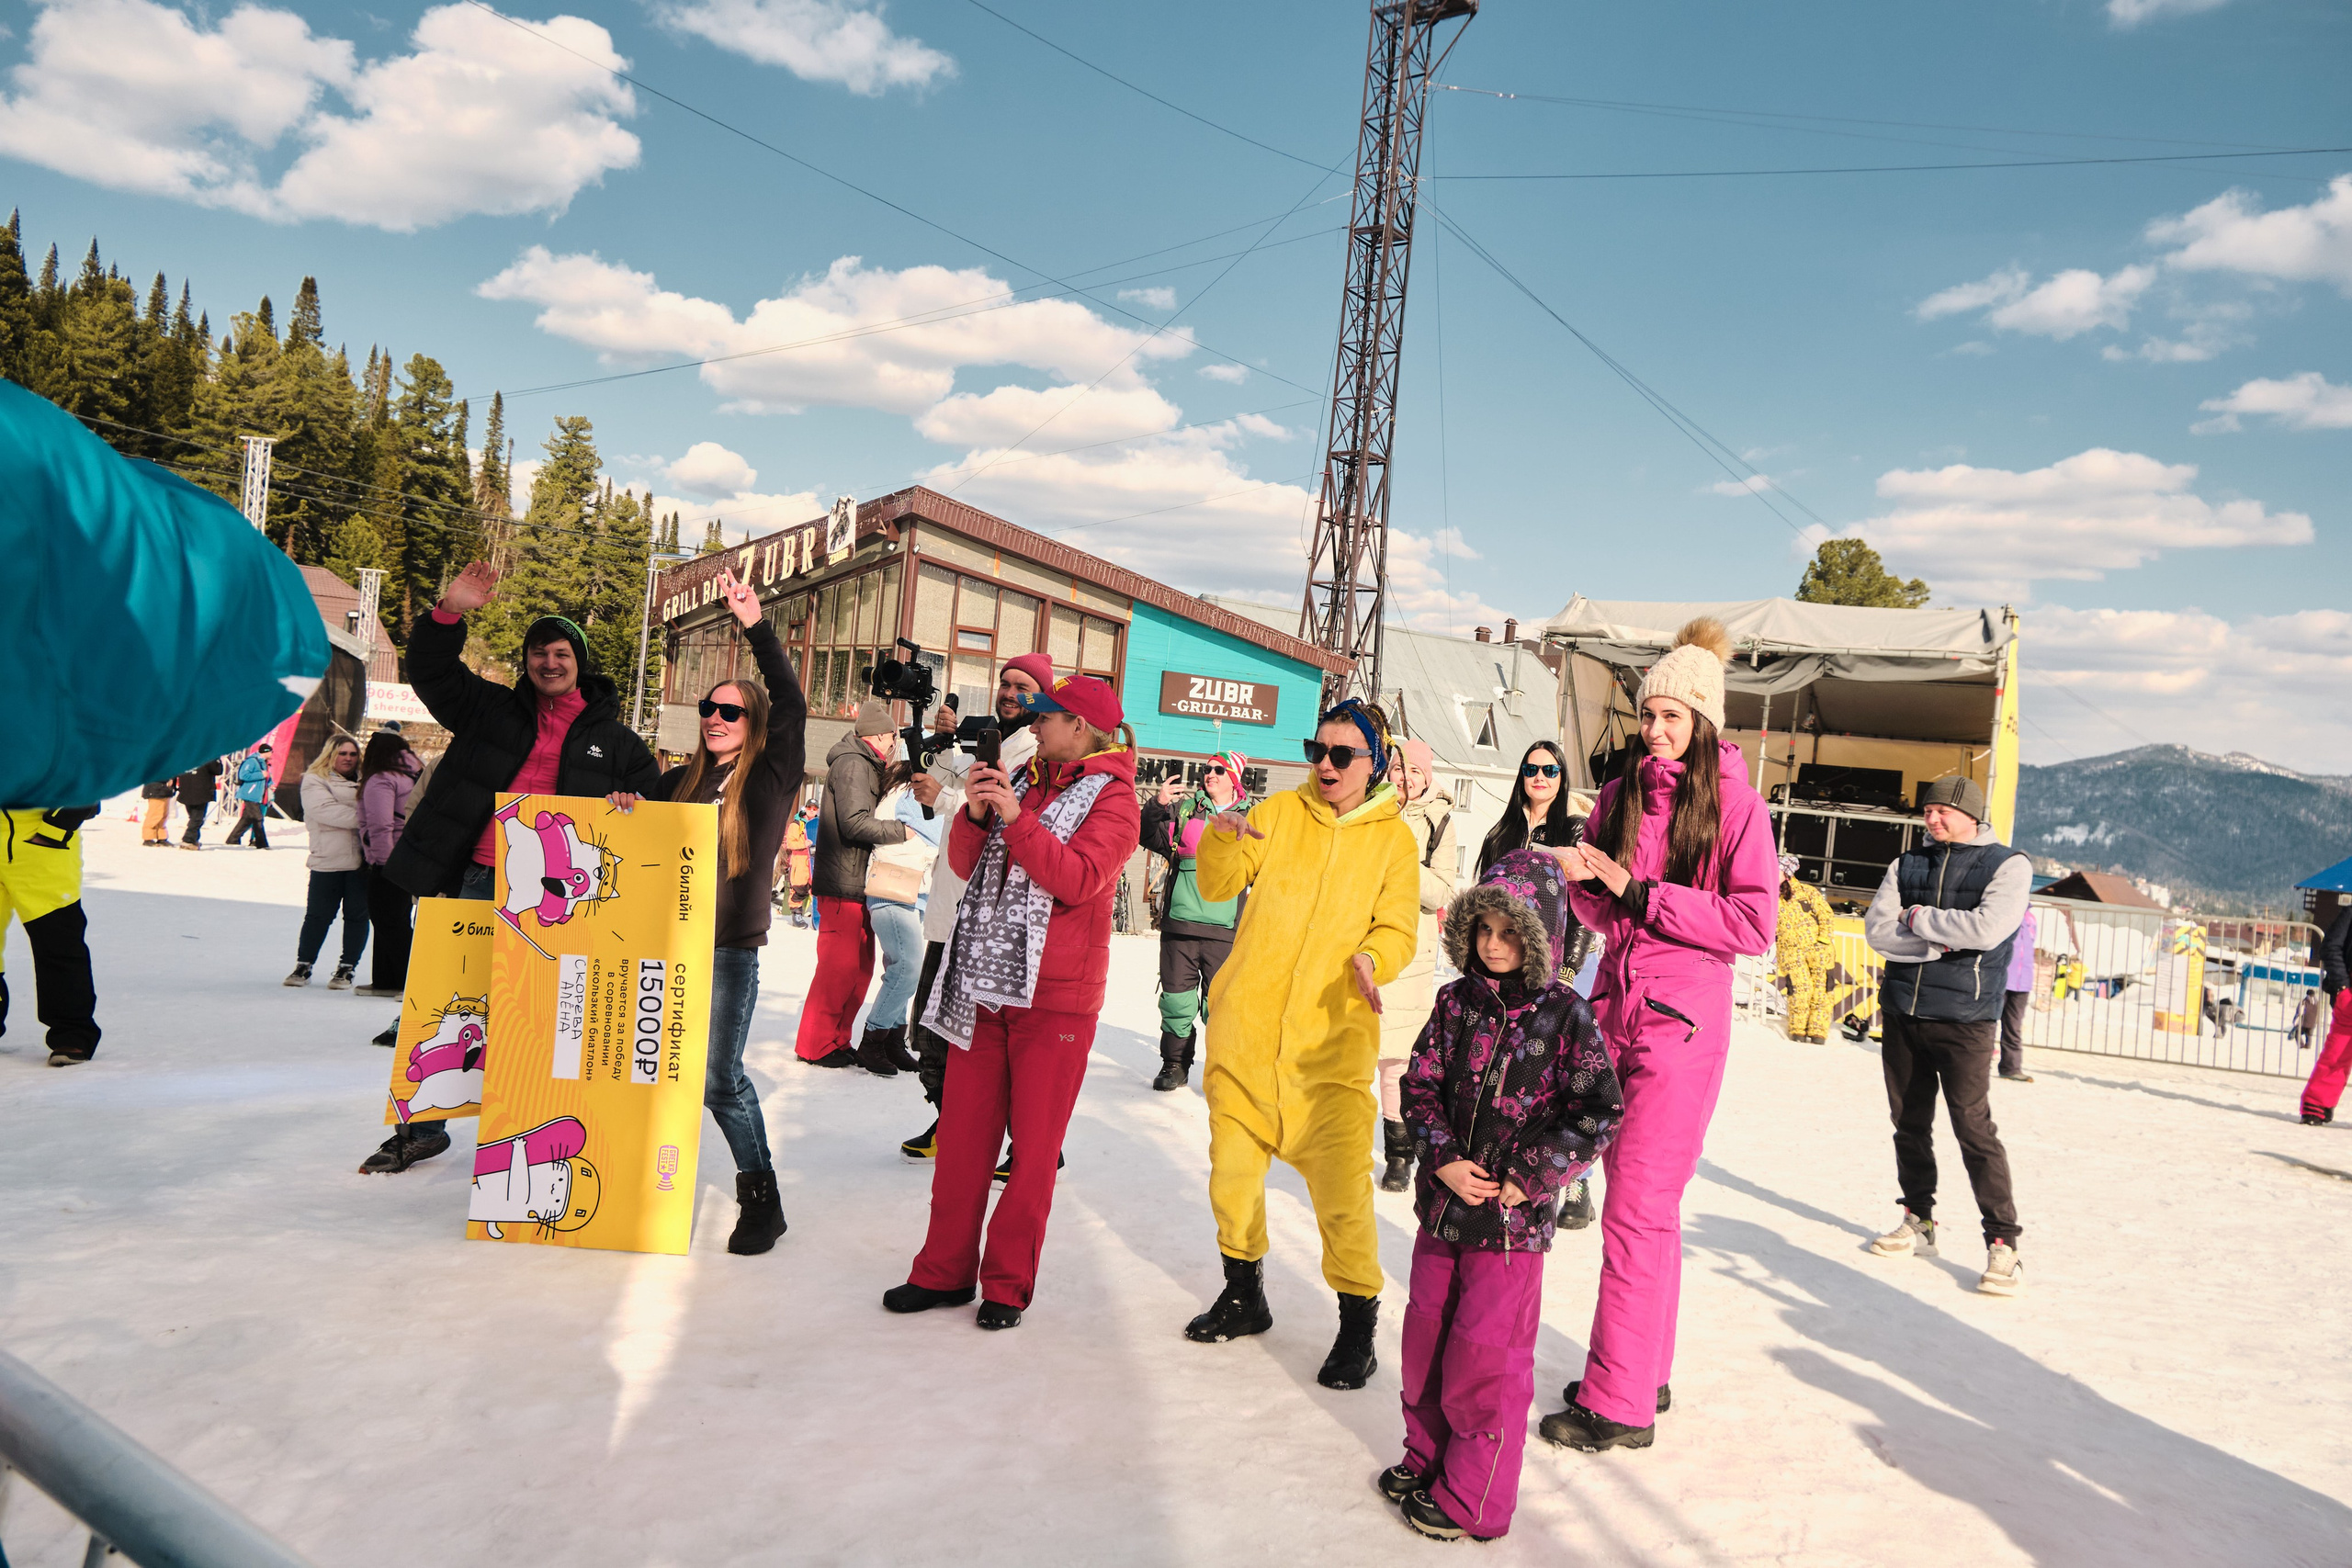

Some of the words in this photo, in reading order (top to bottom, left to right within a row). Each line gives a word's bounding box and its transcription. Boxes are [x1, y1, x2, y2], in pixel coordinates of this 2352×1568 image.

[662, 587, 699, 622] GRILL
[739, 526, 816, 591] ZUBR
[374, 702, 431, 716] shereges
[1189, 677, 1255, 705] ZUBR
[1135, 757, 1174, 787] SK
[1187, 761, 1269, 795] HSE
[679, 864, 694, 920] билайн
[590, 958, 600, 1023] «скользкий
[618, 959, 629, 1018] вручается
[602, 982, 615, 1066] соревновании
[617, 1022, 626, 1034] за
[668, 964, 686, 1082] сертификат
[1058, 1033, 1075, 1043] Y-3
[586, 1027, 598, 1081] биатлон»
[612, 1039, 625, 1081] победу
